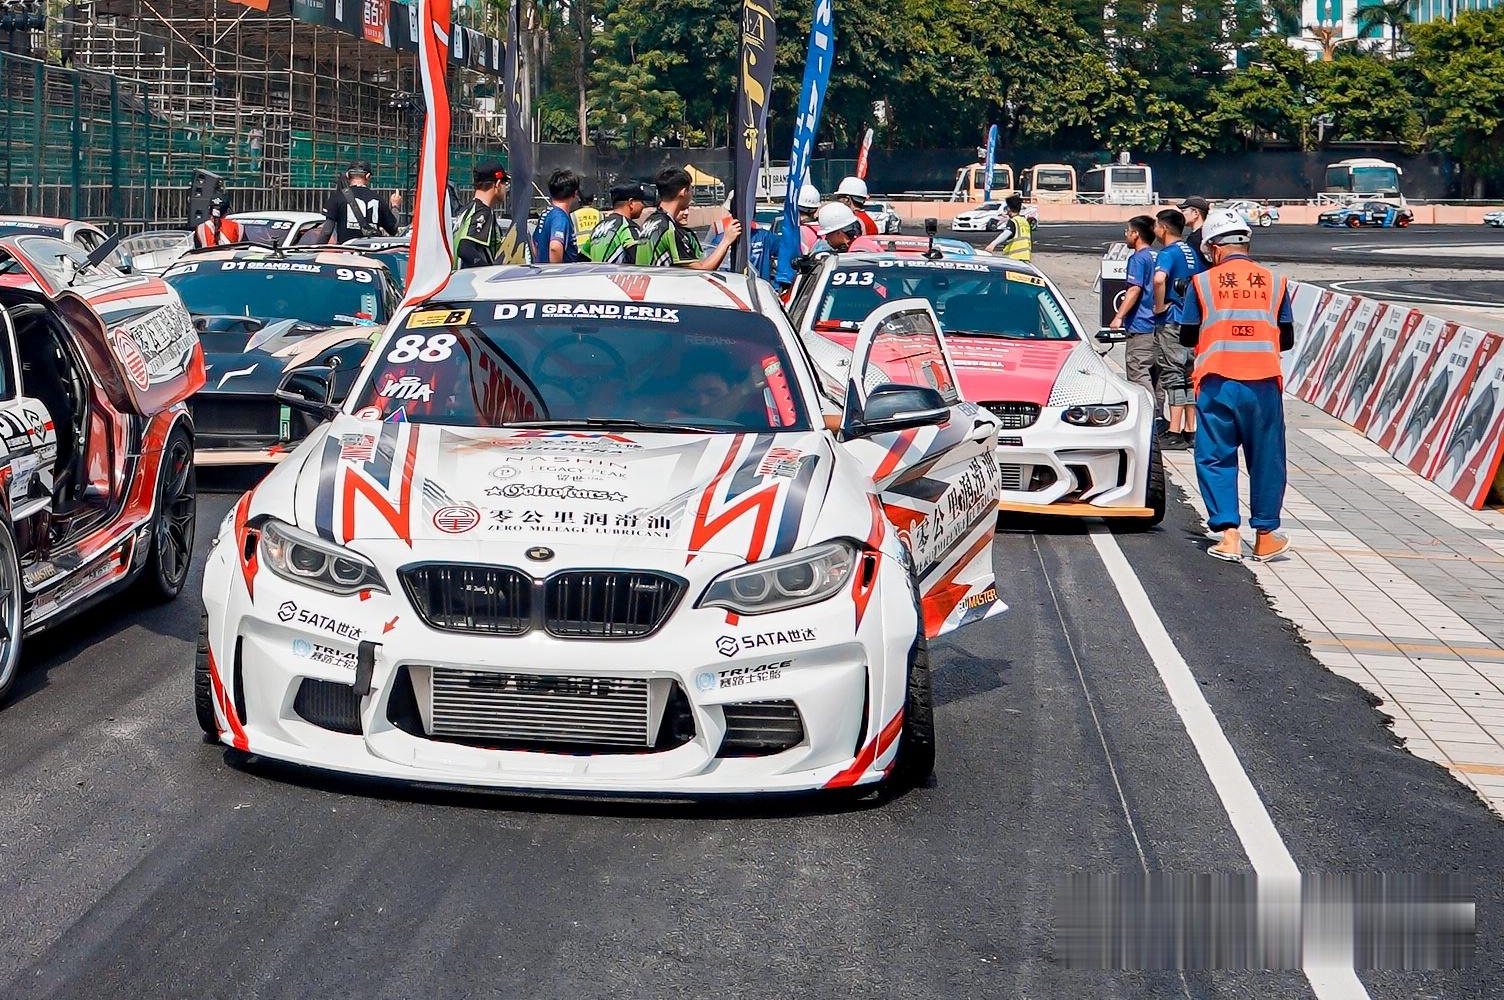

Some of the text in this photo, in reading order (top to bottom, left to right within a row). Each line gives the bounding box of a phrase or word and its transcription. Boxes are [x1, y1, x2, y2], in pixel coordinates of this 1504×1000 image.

[271, 220, 293, 230] 55
[220, 261, 322, 273] D1 GRAND PRIX
[878, 260, 905, 268] D1
[336, 268, 372, 283] 99
[831, 271, 875, 285] 913
[1218, 272, 1267, 289] 媒体
[1218, 289, 1267, 300] MEDIA
[446, 310, 465, 324] B
[493, 302, 680, 321] D1 GRAND PRIX
[1232, 325, 1254, 336] 043
[386, 333, 458, 364] 88
[506, 456, 628, 470] NASHIN
[531, 465, 586, 474] LEGACY
[591, 469, 627, 478] PEAK
[915, 446, 998, 552] 零公里润滑油
[489, 508, 672, 530] 零公里润滑油
[487, 524, 672, 538] ZERO MILEAGE LUBRICANT
[297, 609, 363, 640] SATA世达
[741, 627, 817, 648] SATA世达
[313, 643, 359, 660] TRI-A
[311, 651, 359, 671] 赛路士轮
[718, 660, 793, 678] TRI-ACE
[719, 669, 781, 688] 赛路士轮胎
